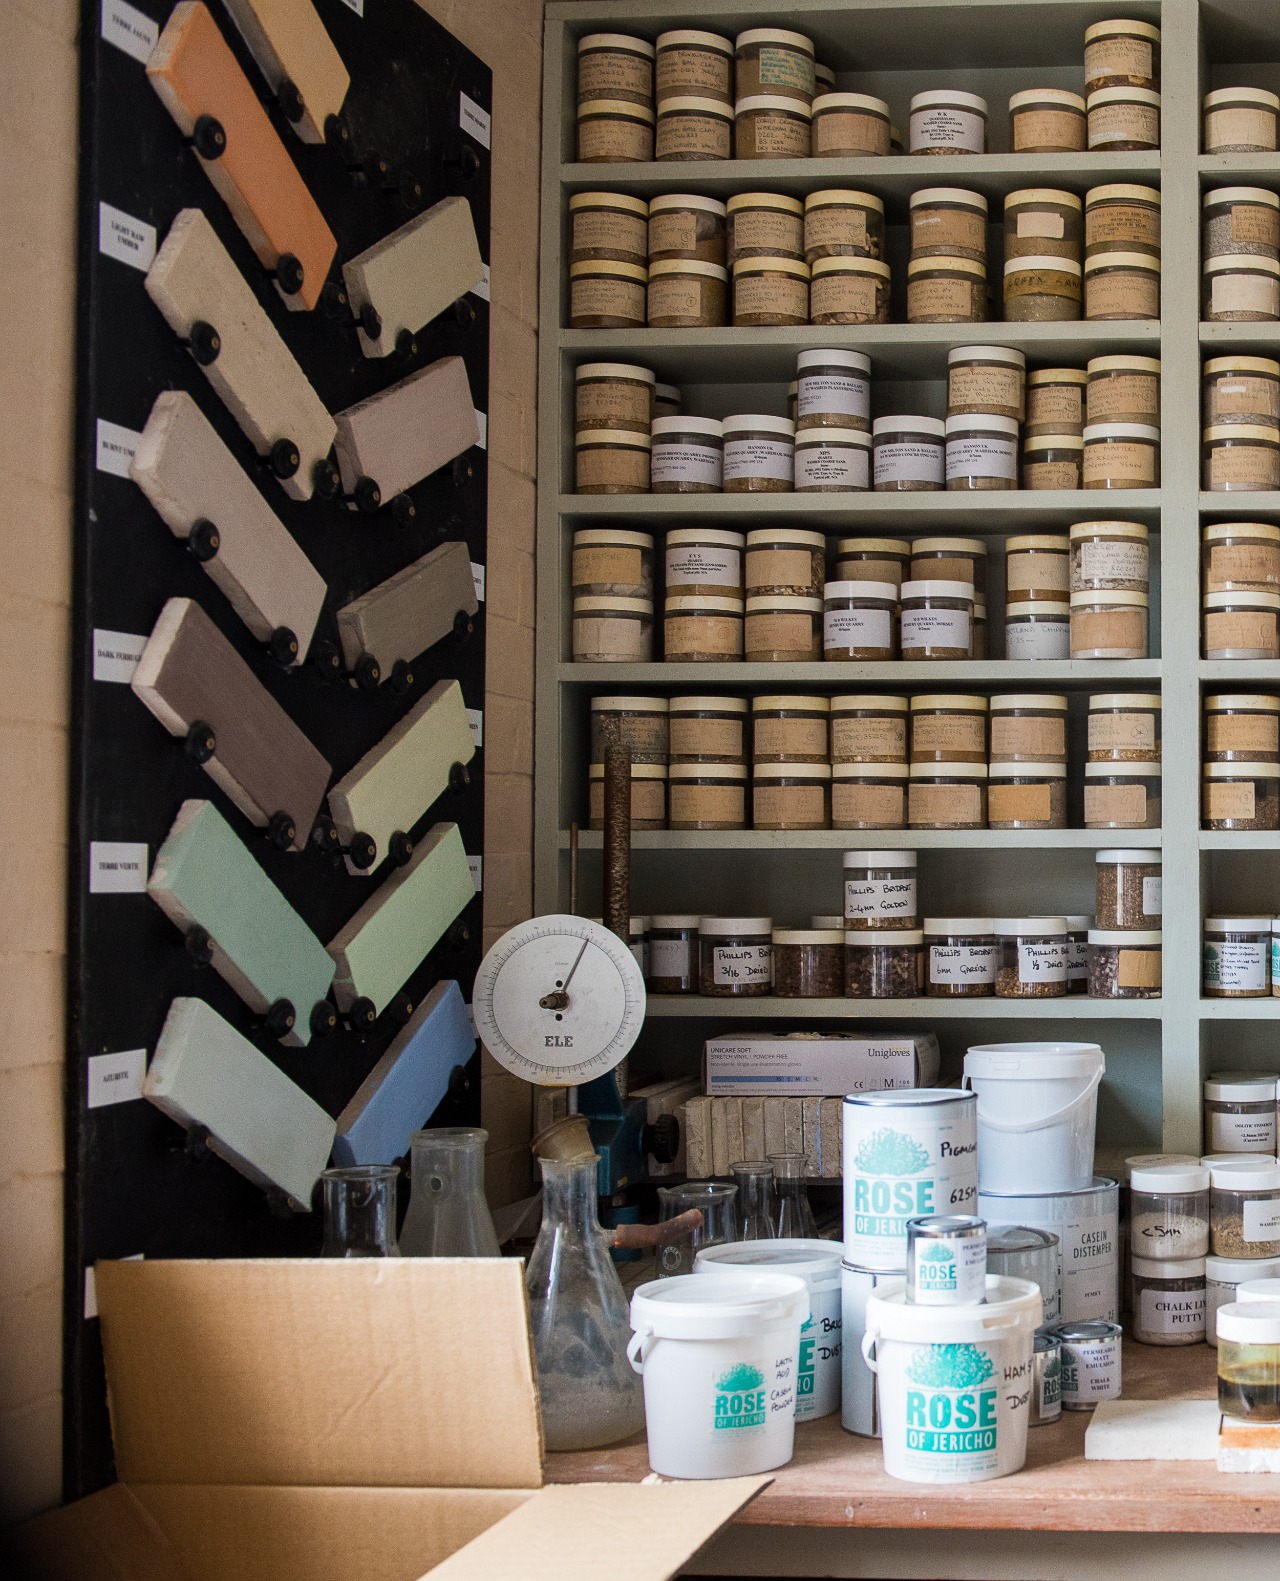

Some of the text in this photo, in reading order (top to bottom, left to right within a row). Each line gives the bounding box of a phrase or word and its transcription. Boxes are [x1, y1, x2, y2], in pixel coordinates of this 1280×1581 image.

[881, 900, 908, 910] GOLDEN
[718, 950, 753, 960] PHILLIPS
[933, 947, 961, 958] PHILLIPS
[1025, 947, 1058, 956] PHILLIPS
[721, 965, 768, 977] 3/16 DRIED
[544, 1036, 574, 1048] ELE
[868, 1048, 910, 1059] Unigloves
[103, 1071, 129, 1082] AZURITE
[885, 1079, 894, 1088] M
[855, 1179, 935, 1214] ROSE
[857, 1217, 906, 1235] OF JERI
[1081, 1230, 1108, 1245] CASEIN
[1073, 1242, 1112, 1259] DISTEMPER
[920, 1264, 957, 1280] ROSE
[1155, 1301, 1193, 1311] CHALK
[1172, 1313, 1203, 1323] PUTTY
[1083, 1346, 1116, 1355] PERMEABLE
[1085, 1360, 1115, 1369] EMULSION
[1003, 1363, 1027, 1381] HAM
[715, 1391, 766, 1416] ROSE
[906, 1391, 997, 1428] ROSE
[717, 1413, 764, 1427] OF JERICHO
[909, 1431, 993, 1450] OF JERICHO
